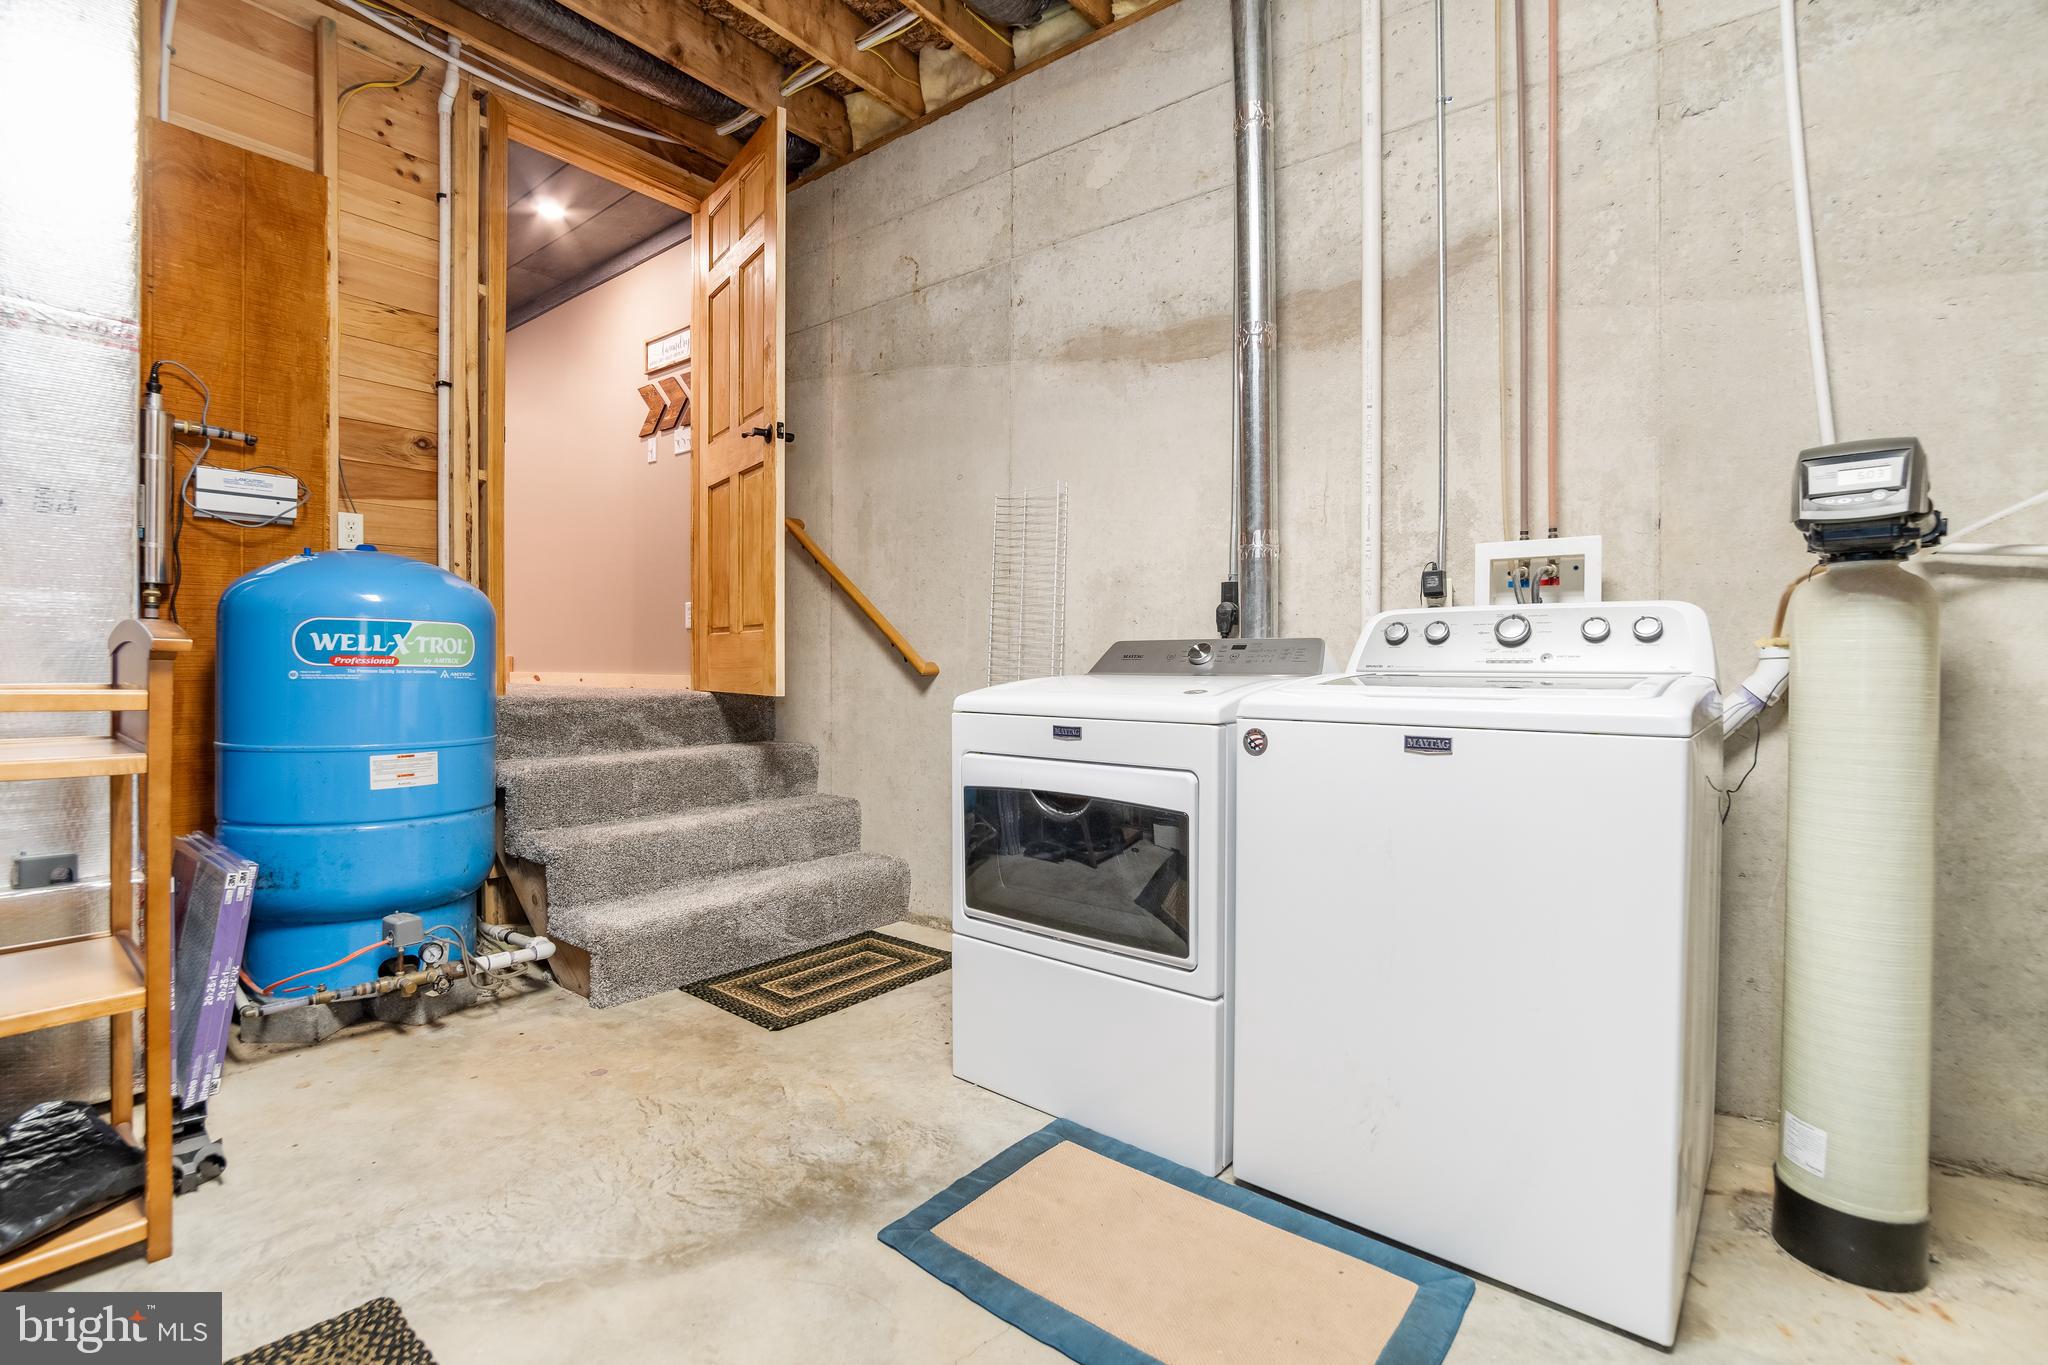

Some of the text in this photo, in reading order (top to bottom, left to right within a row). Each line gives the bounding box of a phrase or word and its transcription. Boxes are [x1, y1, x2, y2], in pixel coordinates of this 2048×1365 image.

[334, 656, 395, 665] Professional
[1054, 727, 1080, 736] MAYTAG
[1406, 737, 1450, 749] MAYTAG
[227, 874, 237, 888] 3M
[239, 871, 249, 885] 3M
